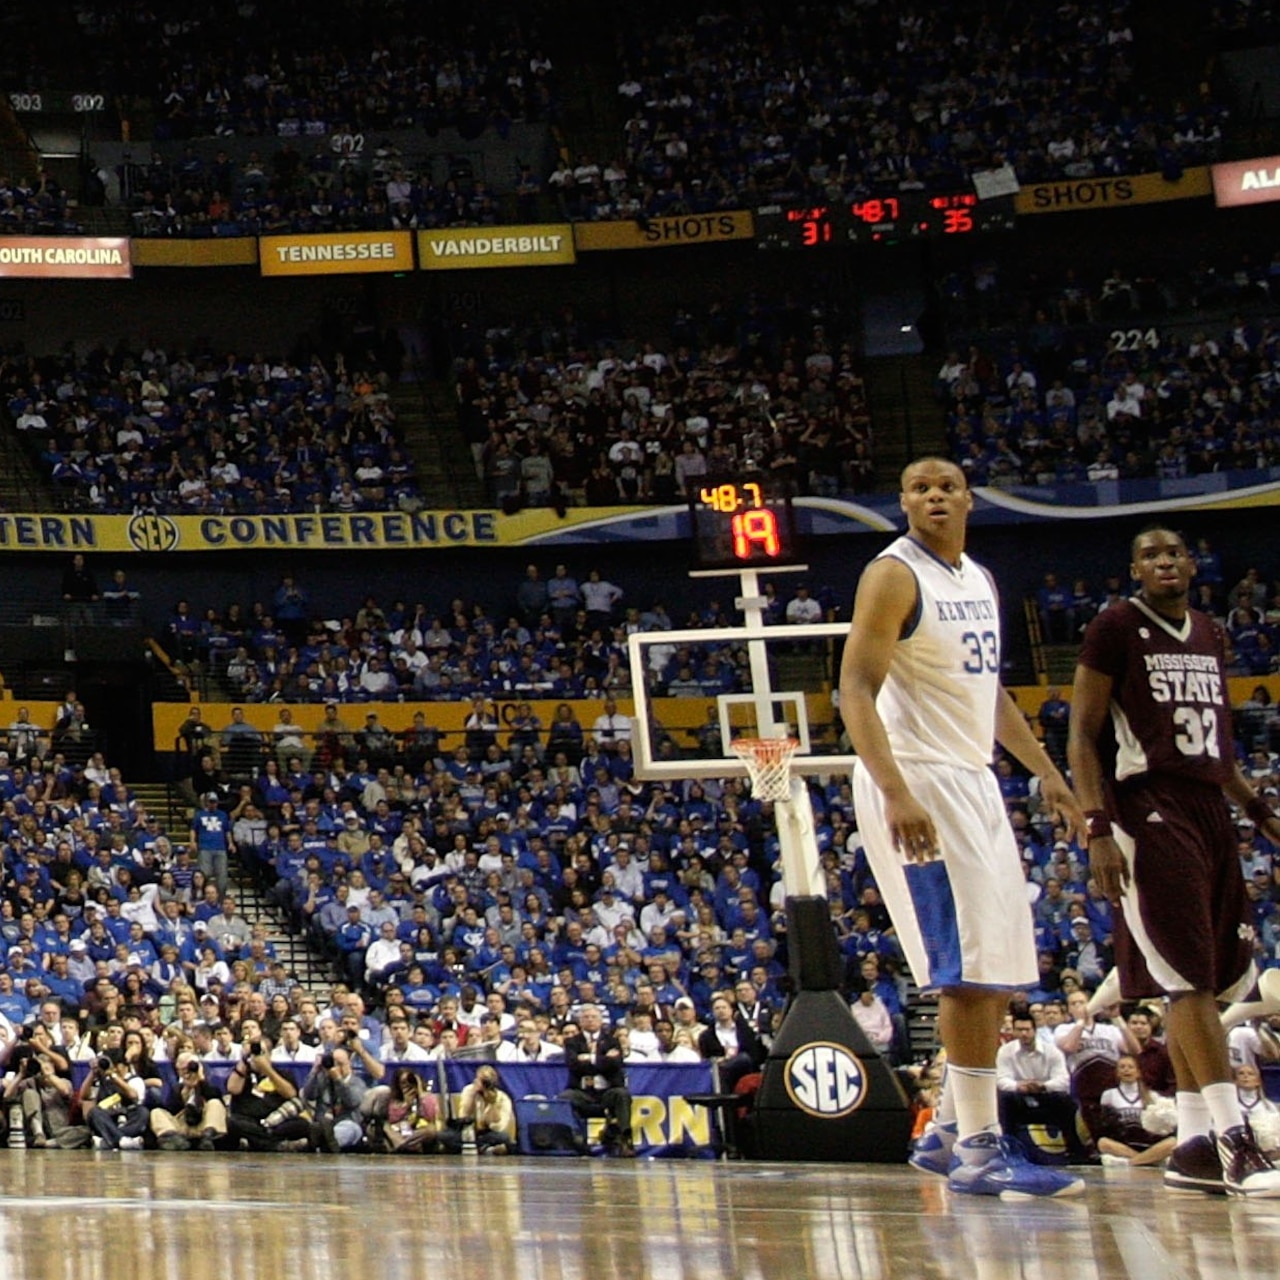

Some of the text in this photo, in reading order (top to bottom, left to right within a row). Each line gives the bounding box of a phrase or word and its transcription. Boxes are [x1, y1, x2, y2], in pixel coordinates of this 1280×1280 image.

[72, 94, 105, 112] 302
[1033, 180, 1134, 208] SHOTS
[646, 215, 737, 242] SHOTS
[803, 222, 831, 245] 31
[45, 247, 123, 266] CAROLINA
[277, 241, 395, 263] TENNESSEE
[430, 234, 562, 257] VANDERBILT
[1110, 326, 1161, 352] 224
[700, 482, 762, 512] 48.7
[131, 516, 176, 551] SEC
[200, 512, 496, 545] CONFERENCE
[731, 509, 781, 559] 19
[961, 630, 999, 675] 33
[1148, 671, 1224, 706] STATE
[1173, 706, 1221, 760] 32
[790, 1046, 864, 1115] SEC
